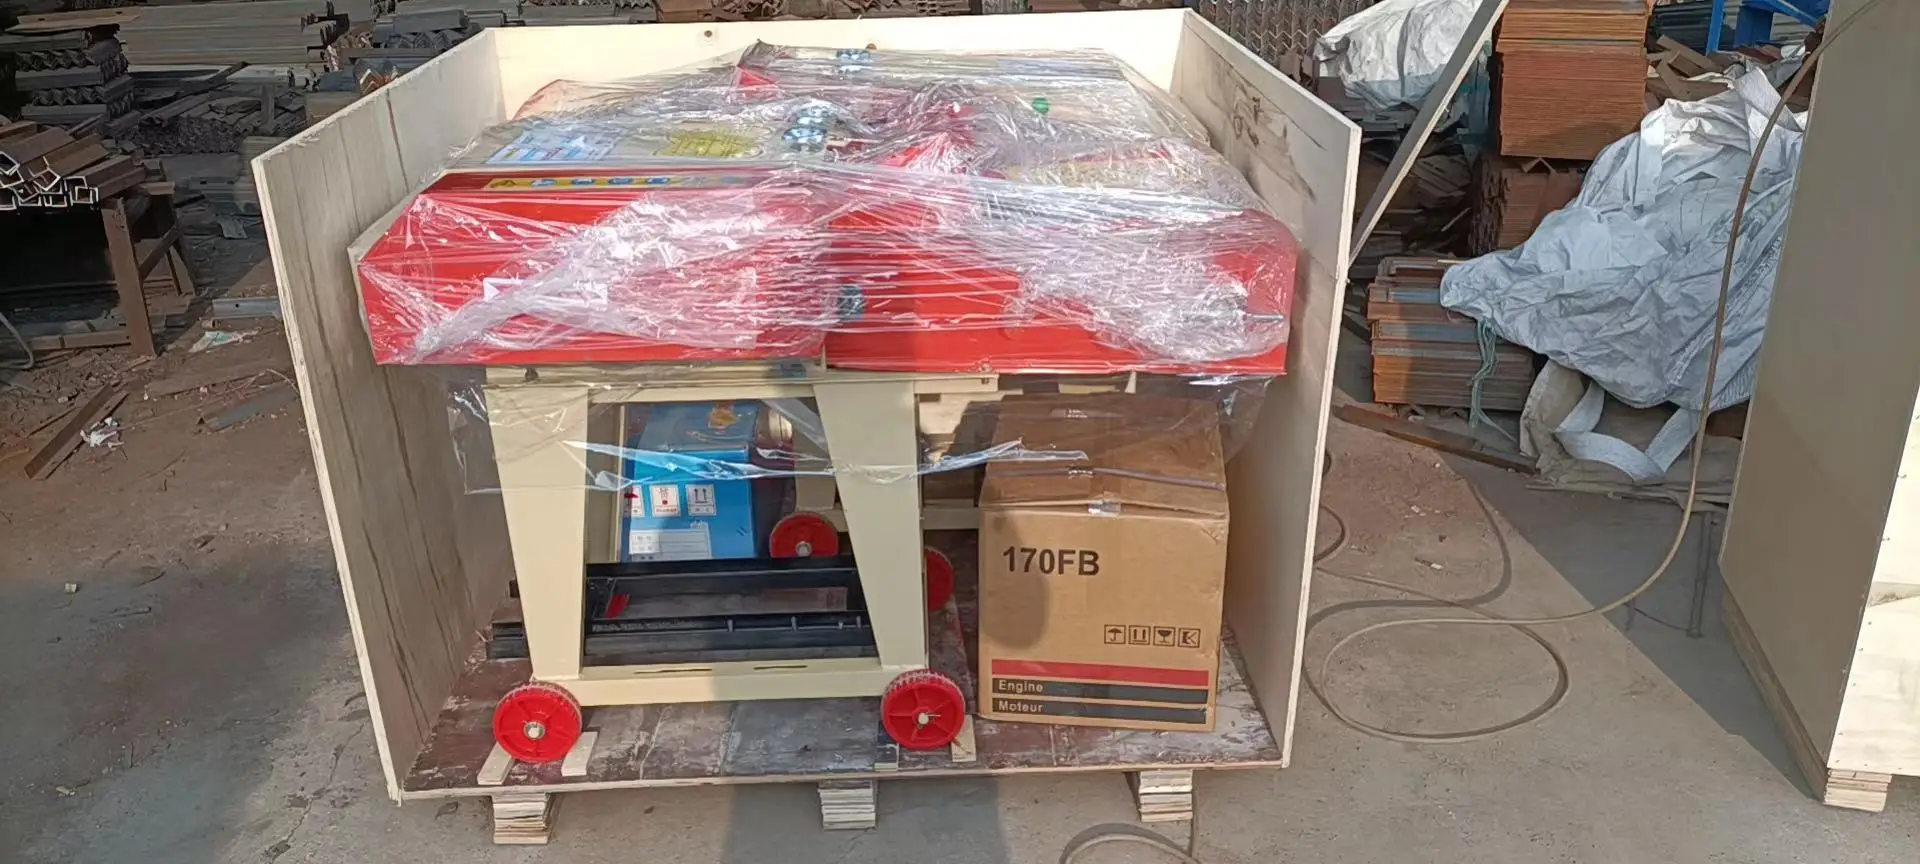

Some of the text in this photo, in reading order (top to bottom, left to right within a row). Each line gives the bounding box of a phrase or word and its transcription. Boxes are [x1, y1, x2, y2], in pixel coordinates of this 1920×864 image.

[1003, 546, 1100, 575] 170FB
[999, 680, 1043, 693] Engine
[999, 700, 1044, 712] Moteur
